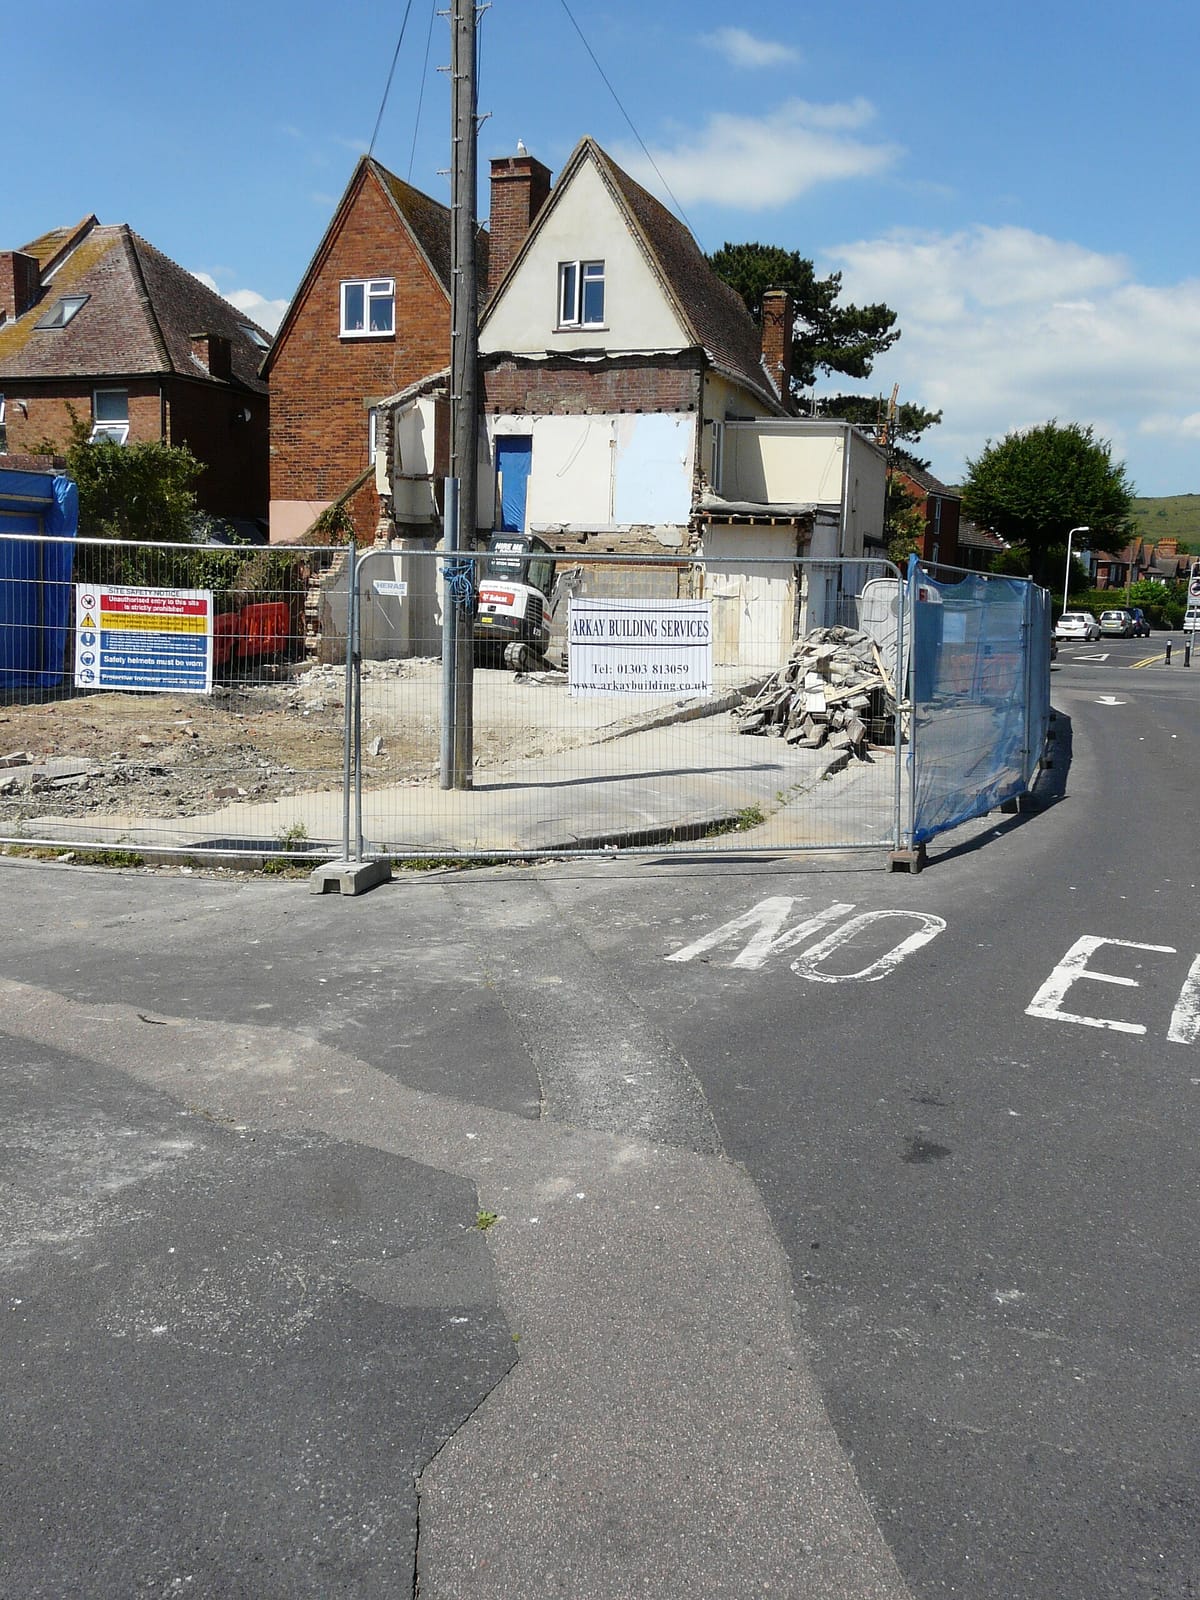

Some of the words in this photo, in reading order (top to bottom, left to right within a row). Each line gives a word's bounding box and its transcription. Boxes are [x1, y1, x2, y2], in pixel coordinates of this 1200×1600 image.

[108, 587, 125, 595] SITE
[126, 588, 153, 596] SAFETY
[109, 595, 150, 604] Unauthorised
[131, 604, 152, 612] strictly
[153, 605, 184, 613] prohibited
[571, 619, 606, 637] ARKAY
[608, 619, 658, 637] BUILDING
[660, 619, 709, 638] SERVICES
[103, 655, 126, 665] Safety
[127, 656, 155, 665] helmets
[156, 658, 174, 666] must
[591, 663, 613, 674] Tel:
[616, 664, 648, 675] 01303
[652, 664, 689, 675] 813059
[573, 680, 708, 691] www.arkaybuilding.co.uk
[664, 896, 947, 983] NO
[1024, 934, 1200, 1045] E
